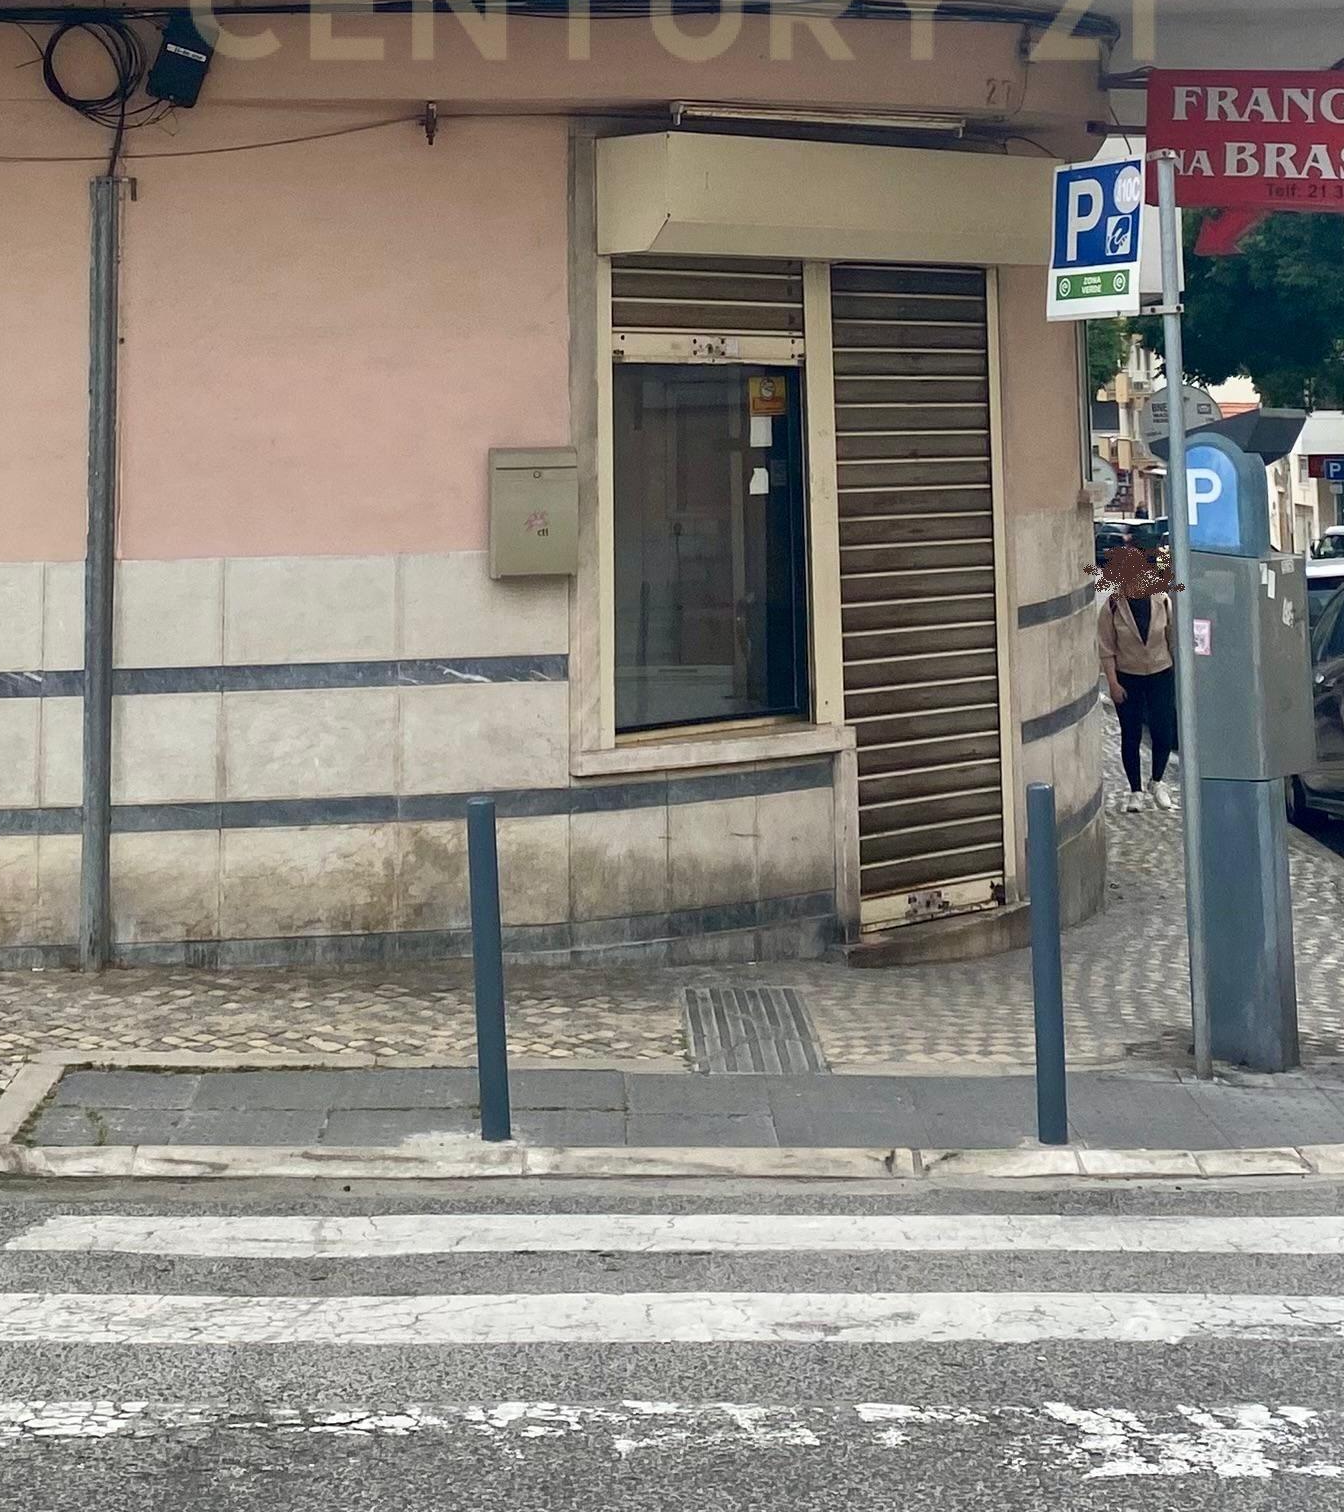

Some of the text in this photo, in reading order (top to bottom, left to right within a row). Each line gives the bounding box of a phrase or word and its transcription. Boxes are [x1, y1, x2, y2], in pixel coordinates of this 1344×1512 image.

[1172, 149, 1215, 177] NA
[1308, 184, 1327, 199] 21
[1066, 178, 1105, 262] P
[1083, 275, 1102, 286] ZONA
[1329, 463, 1342, 477] P
[1186, 468, 1222, 526] P
